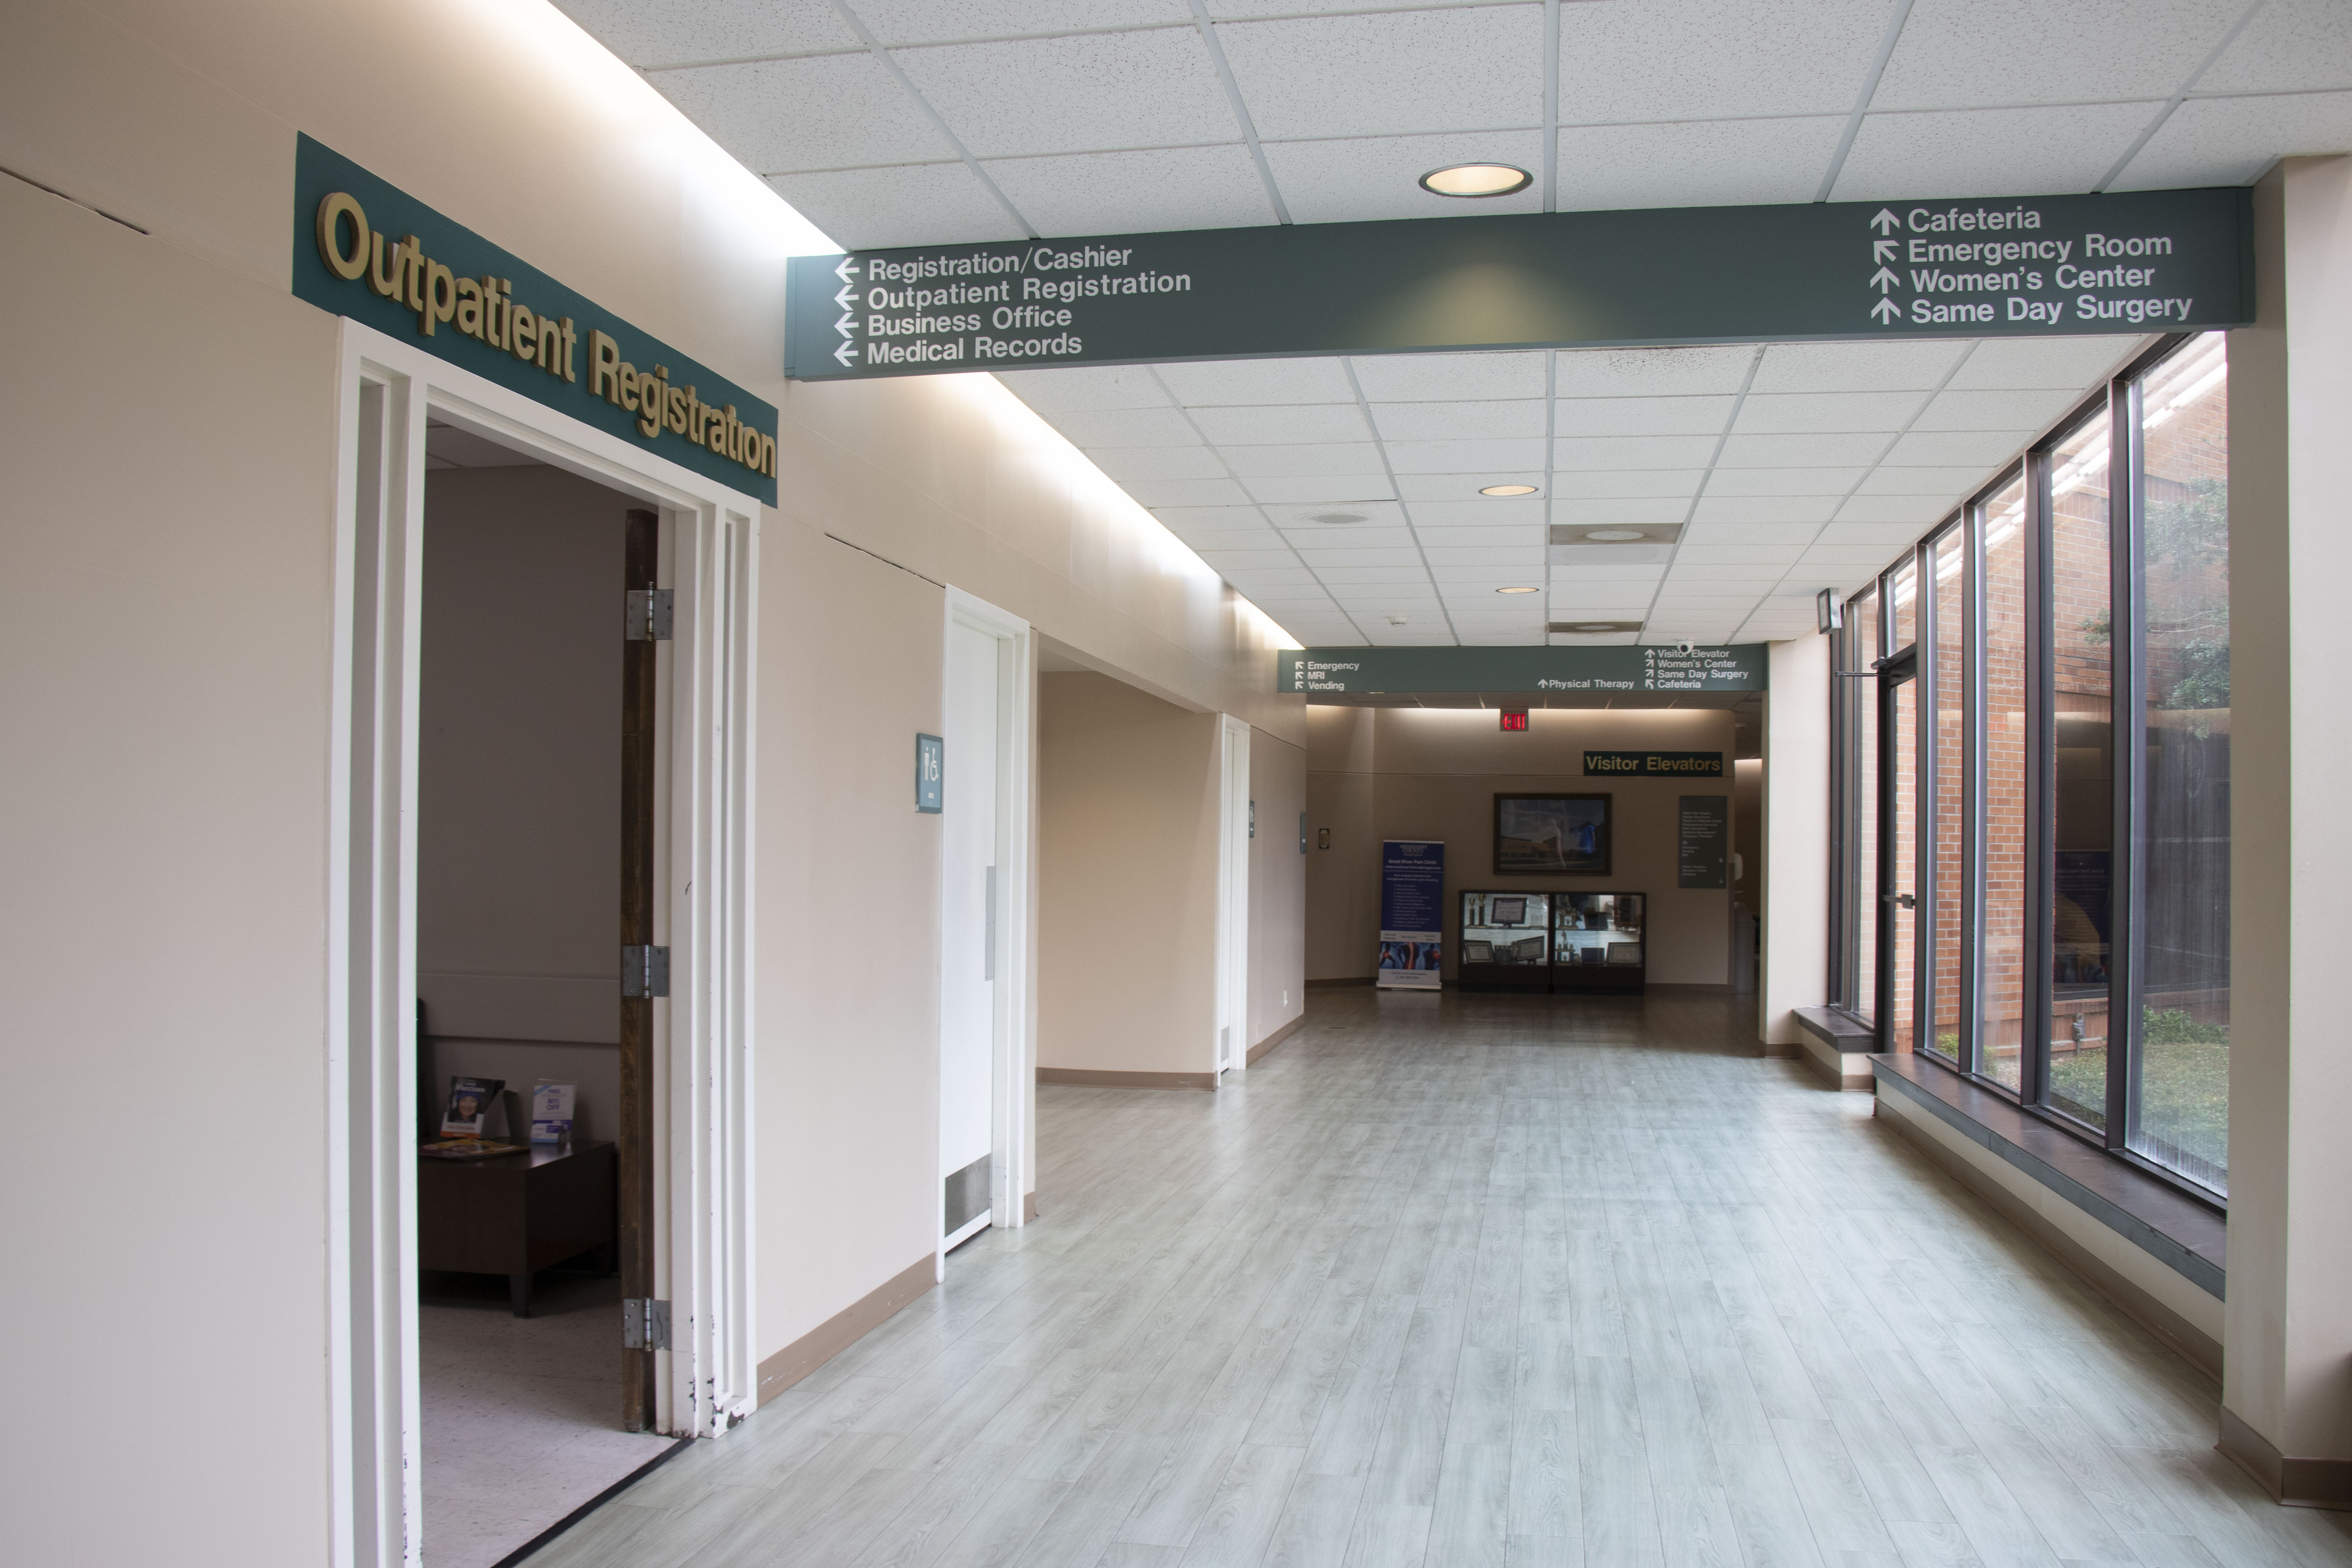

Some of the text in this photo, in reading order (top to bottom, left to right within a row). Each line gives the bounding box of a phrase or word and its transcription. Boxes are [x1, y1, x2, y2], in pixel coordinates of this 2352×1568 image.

[1908, 206, 2041, 233] Cafeteria
[1909, 233, 2172, 265] Emergency Room
[868, 245, 1132, 283] Registration/Cashier
[1910, 264, 2155, 293] Women's Center
[868, 271, 1191, 311] Outpatient Registration
[1911, 295, 2192, 325] Same Day Surgery
[868, 305, 1072, 337] Business Office
[316, 192, 776, 478] Outpatient Registration
[868, 332, 1082, 365] Medical Records
[1691, 649, 1730, 658] Elevator
[1308, 661, 1359, 671] Emergency
[1657, 659, 1737, 668] Women's Center
[1308, 671, 1325, 680] MRI
[1657, 669, 1748, 680] Same Day Surgery
[1308, 681, 1344, 691] Vending
[1549, 679, 1635, 689] Physical Therapy
[1657, 680, 1701, 688] Cafeteria
[1504, 713, 1525, 730] EXIT
[1586, 756, 1721, 771] Visitor Elevators
